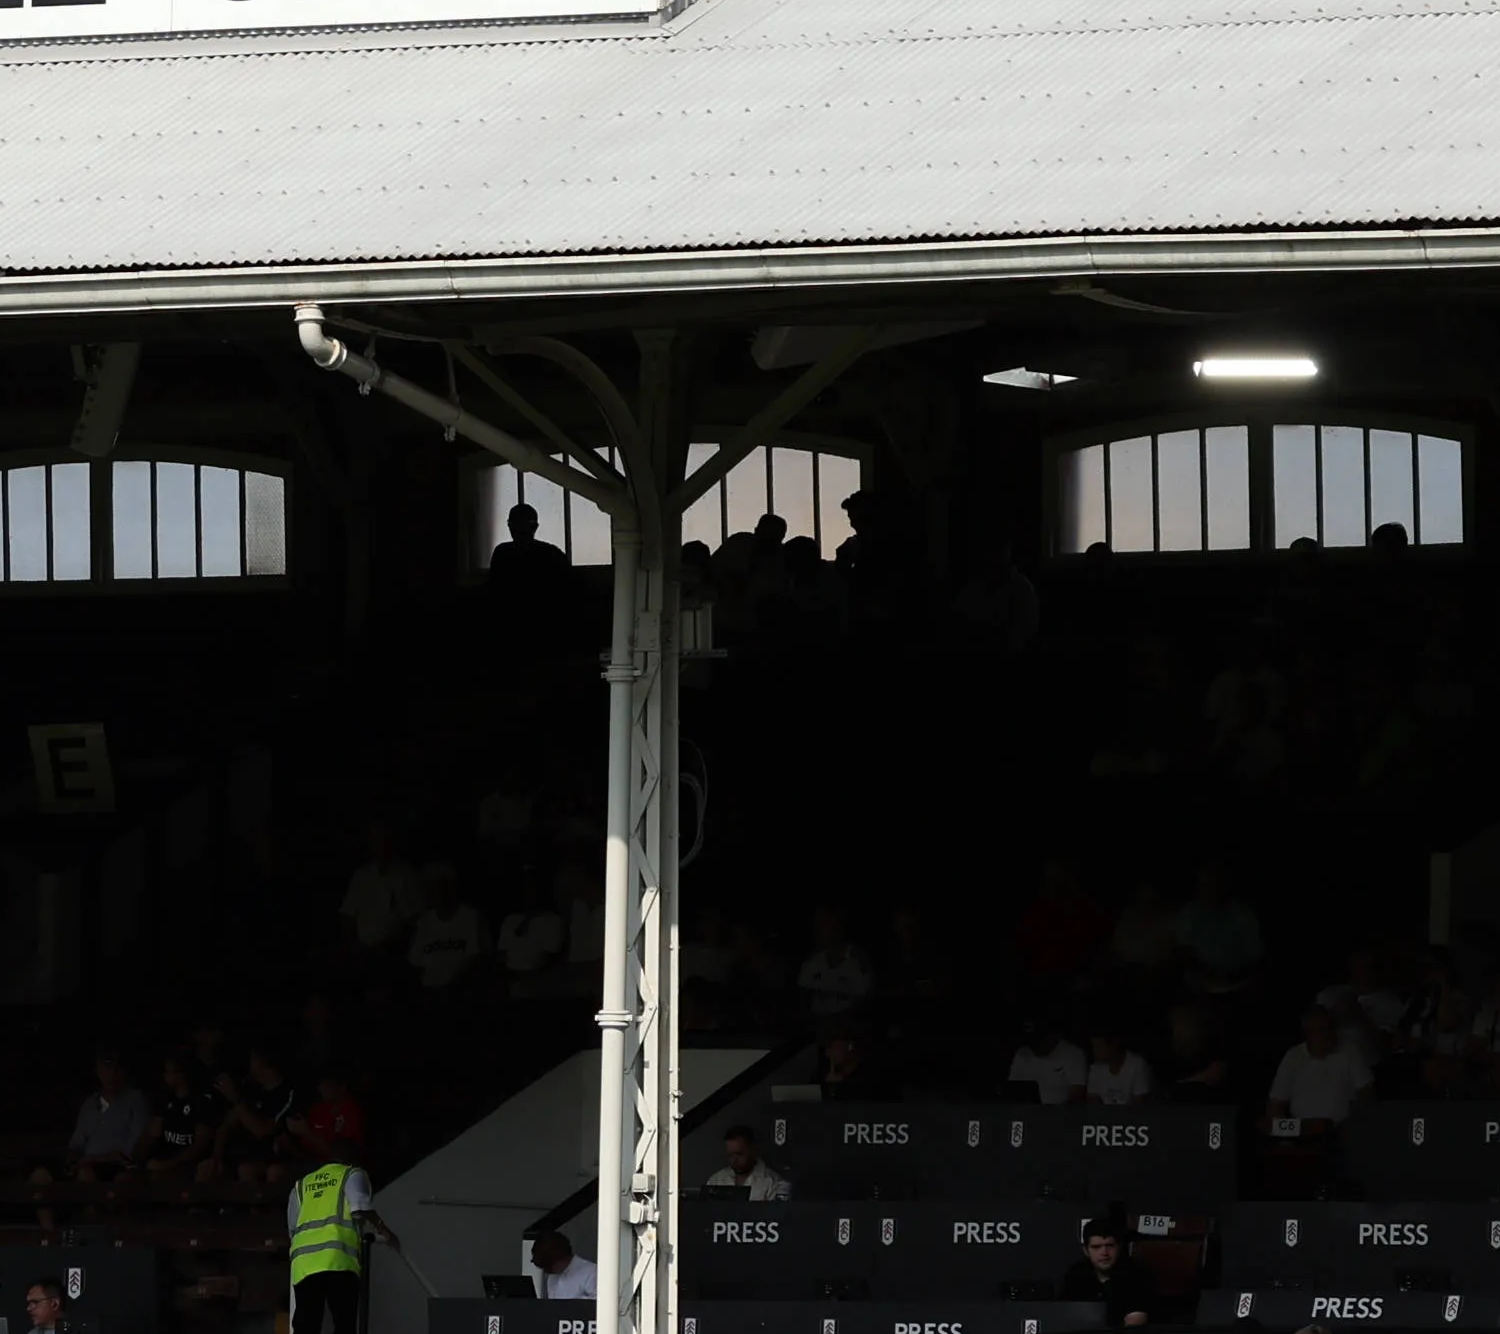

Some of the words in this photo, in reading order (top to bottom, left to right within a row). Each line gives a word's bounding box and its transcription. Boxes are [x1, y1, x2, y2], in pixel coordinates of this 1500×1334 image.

[47, 738, 95, 798] E
[844, 1123, 909, 1144] PRESS
[1082, 1125, 1149, 1147] PRESS
[1278, 1120, 1296, 1131] C6
[713, 1221, 779, 1243] PRESS
[953, 1222, 1021, 1244] PRESS
[1143, 1216, 1165, 1228] B16
[1359, 1223, 1429, 1246] PRESS
[1311, 1297, 1383, 1319] PRESS
